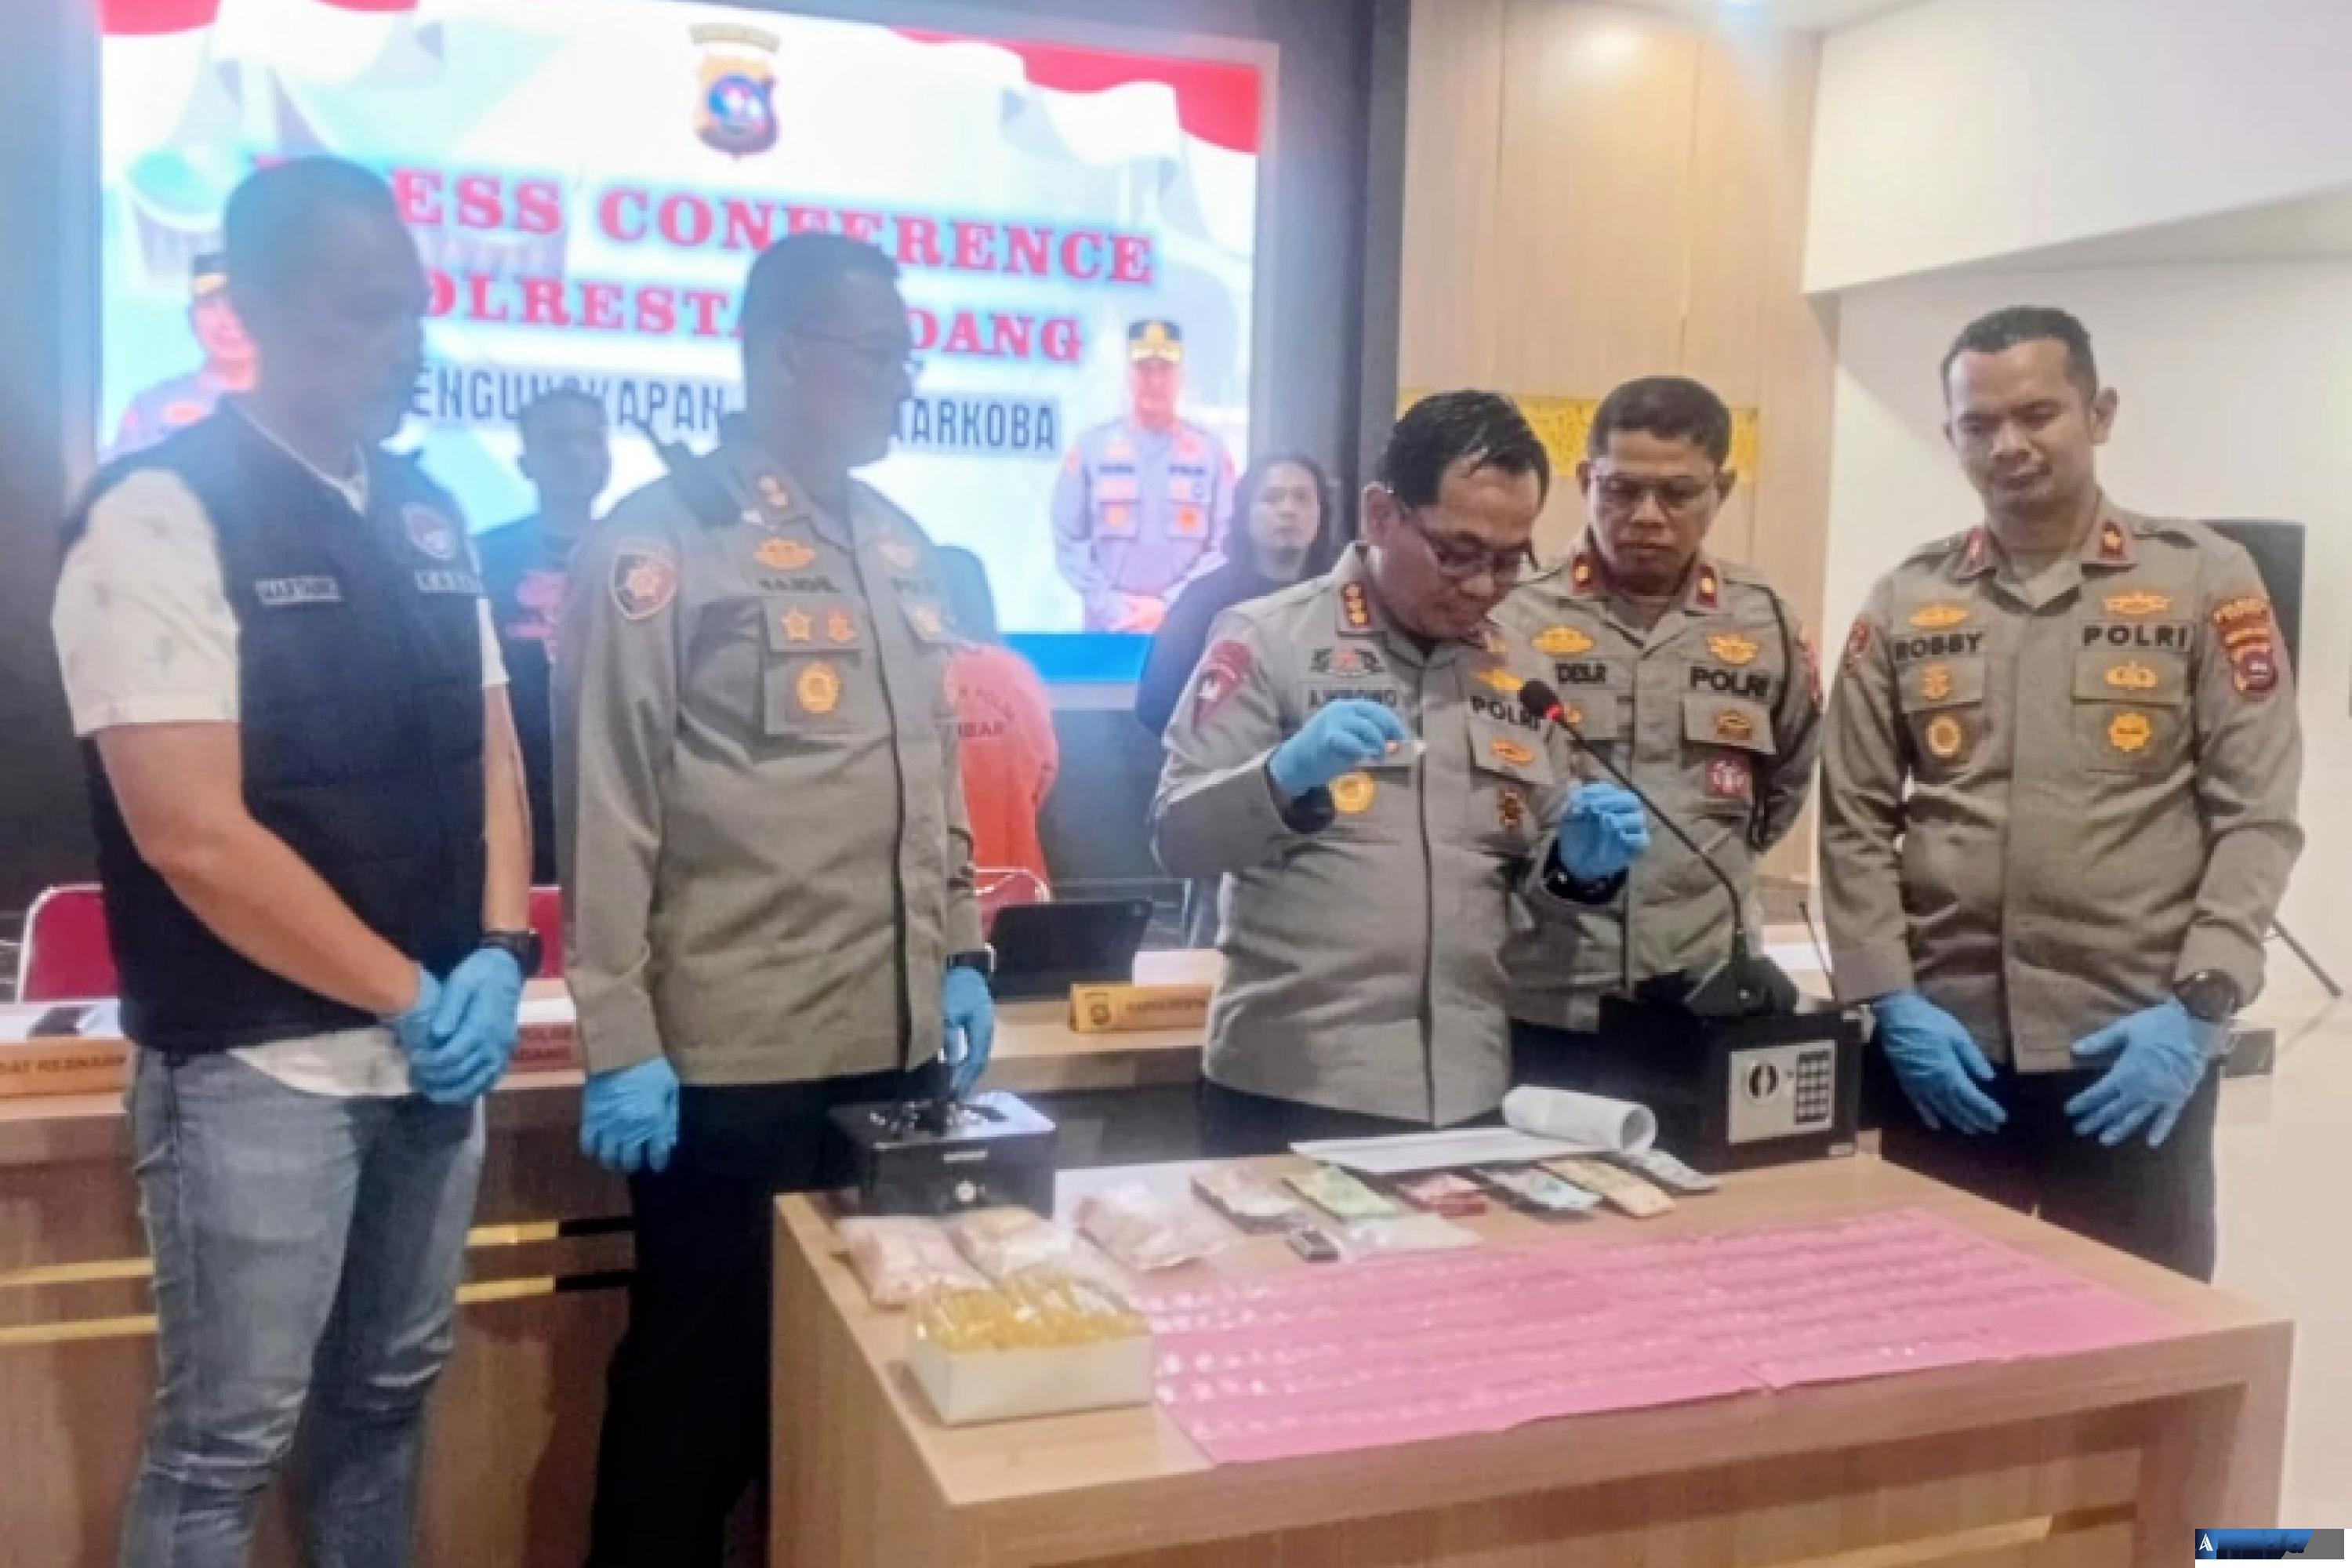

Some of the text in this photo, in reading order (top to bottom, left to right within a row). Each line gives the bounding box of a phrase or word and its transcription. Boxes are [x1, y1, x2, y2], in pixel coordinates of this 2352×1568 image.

[393, 167, 564, 235] ESS
[428, 267, 1083, 362] OLREST DANG
[2082, 625, 2188, 647] POLRI
[1690, 666, 1769, 698] POLRI
